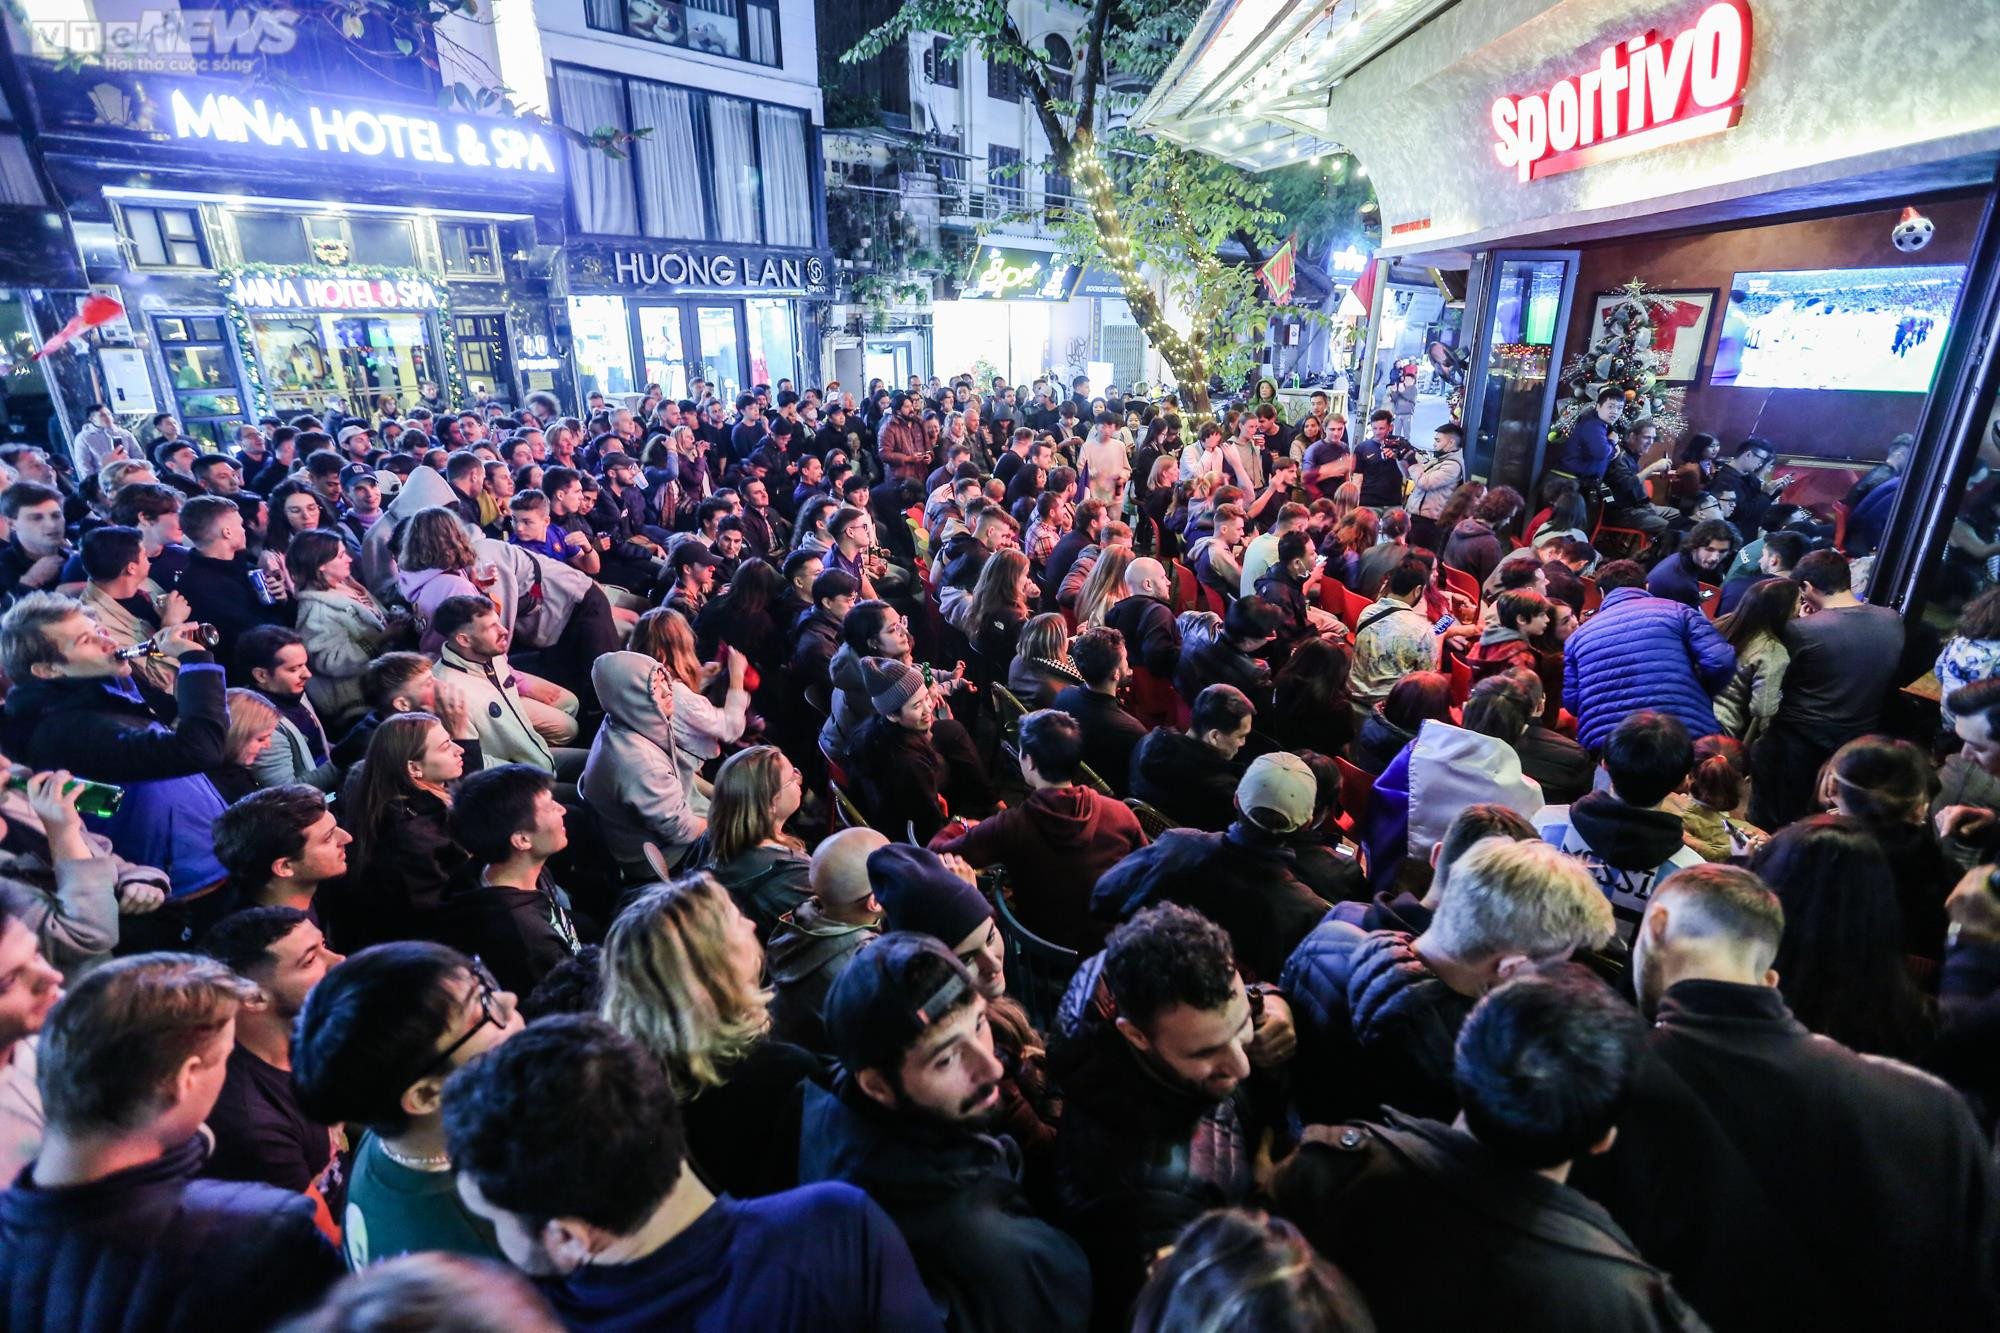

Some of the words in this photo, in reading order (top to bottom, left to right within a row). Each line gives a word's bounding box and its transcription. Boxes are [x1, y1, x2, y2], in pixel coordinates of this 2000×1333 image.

[1491, 1, 1748, 184] sportivo
[171, 88, 308, 150] MINA
[310, 107, 454, 164] HOTEL
[457, 123, 490, 167] &
[490, 127, 556, 173] SPA
[235, 274, 303, 307] MINA
[304, 278, 381, 308] HOTEL
[397, 280, 440, 308] SPA
[614, 251, 737, 286] HUONG
[743, 258, 801, 287] LAN
